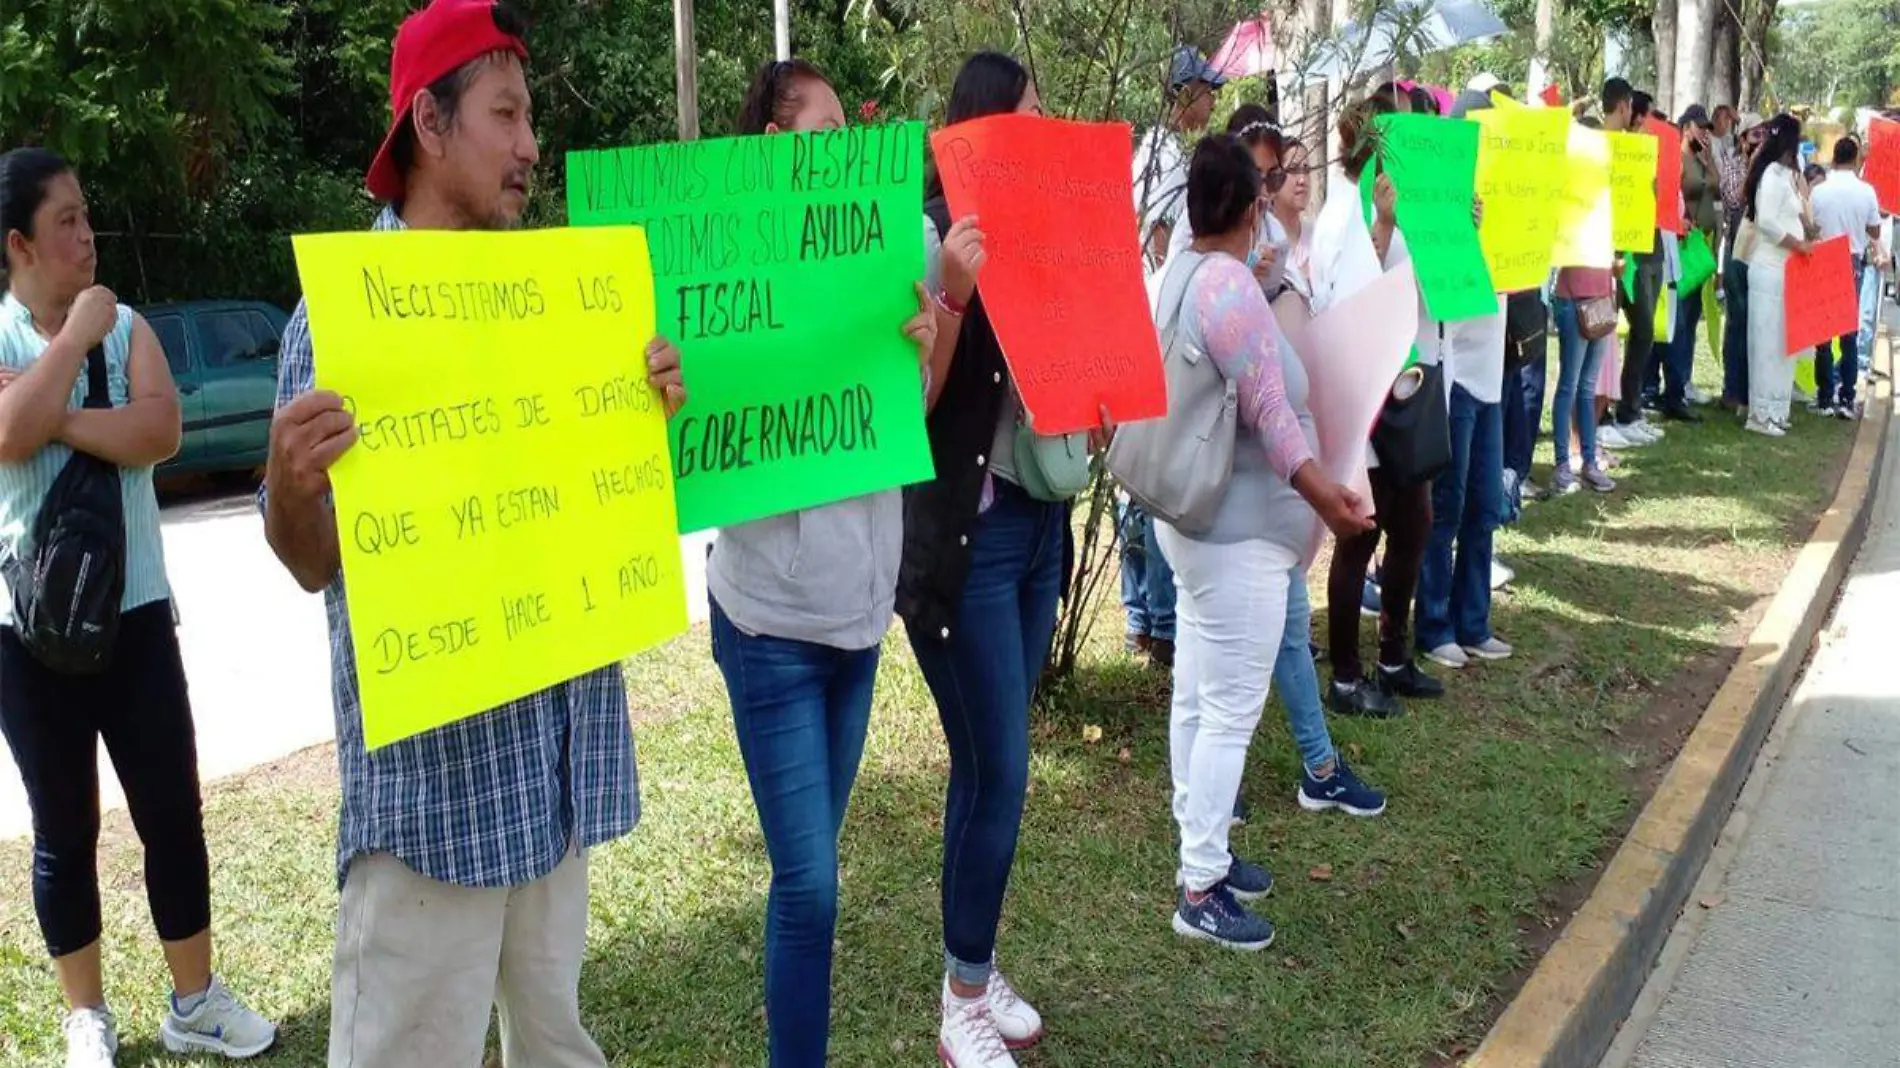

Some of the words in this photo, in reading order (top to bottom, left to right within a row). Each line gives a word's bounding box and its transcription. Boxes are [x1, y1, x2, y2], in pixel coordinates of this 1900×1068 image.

[581, 143, 709, 212] VENIMOS
[725, 133, 774, 196] CON
[791, 122, 910, 193] RESPETO
[754, 206, 791, 267] SU
[800, 201, 884, 261] AYUDA
[578, 275, 623, 313] LOS
[677, 279, 784, 341] FISCAL
[515, 397, 550, 430] DE
[575, 376, 651, 417] DAÑOS
[676, 384, 877, 479] GOBERNADOR
[354, 510, 420, 555] QUE
[451, 496, 485, 539] YA
[496, 486, 560, 529] ESTAN
[592, 454, 665, 502] HECHOS
[374, 617, 479, 675] DESDE
[502, 592, 551, 642] HACE
[582, 577, 596, 612] 1
